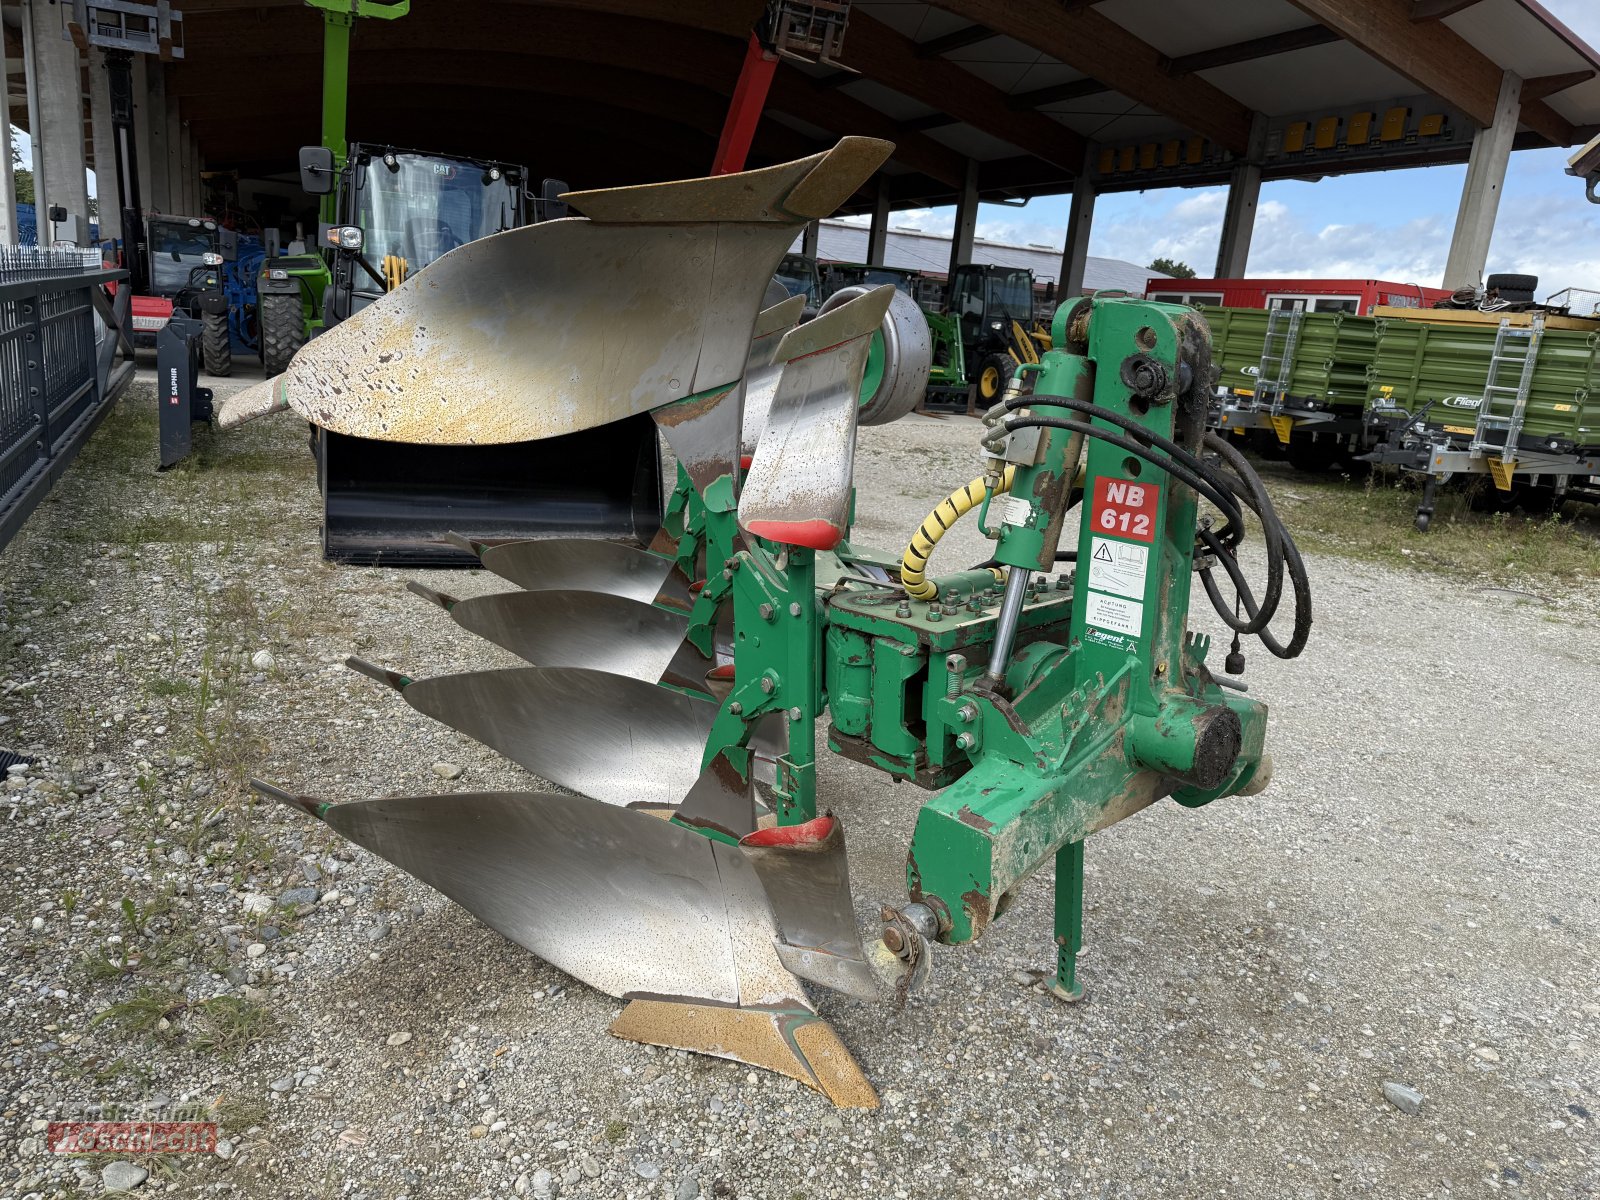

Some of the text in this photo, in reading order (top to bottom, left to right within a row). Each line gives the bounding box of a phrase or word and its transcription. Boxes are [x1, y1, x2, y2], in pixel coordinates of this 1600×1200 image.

[433, 164, 450, 176] CAT
[170, 367, 178, 396] SAPHIR
[1107, 482, 1145, 507] NB
[1101, 508, 1150, 535] 612
[1100, 599, 1127, 609] ACHTUNG
[1085, 627, 1124, 643] Regent
